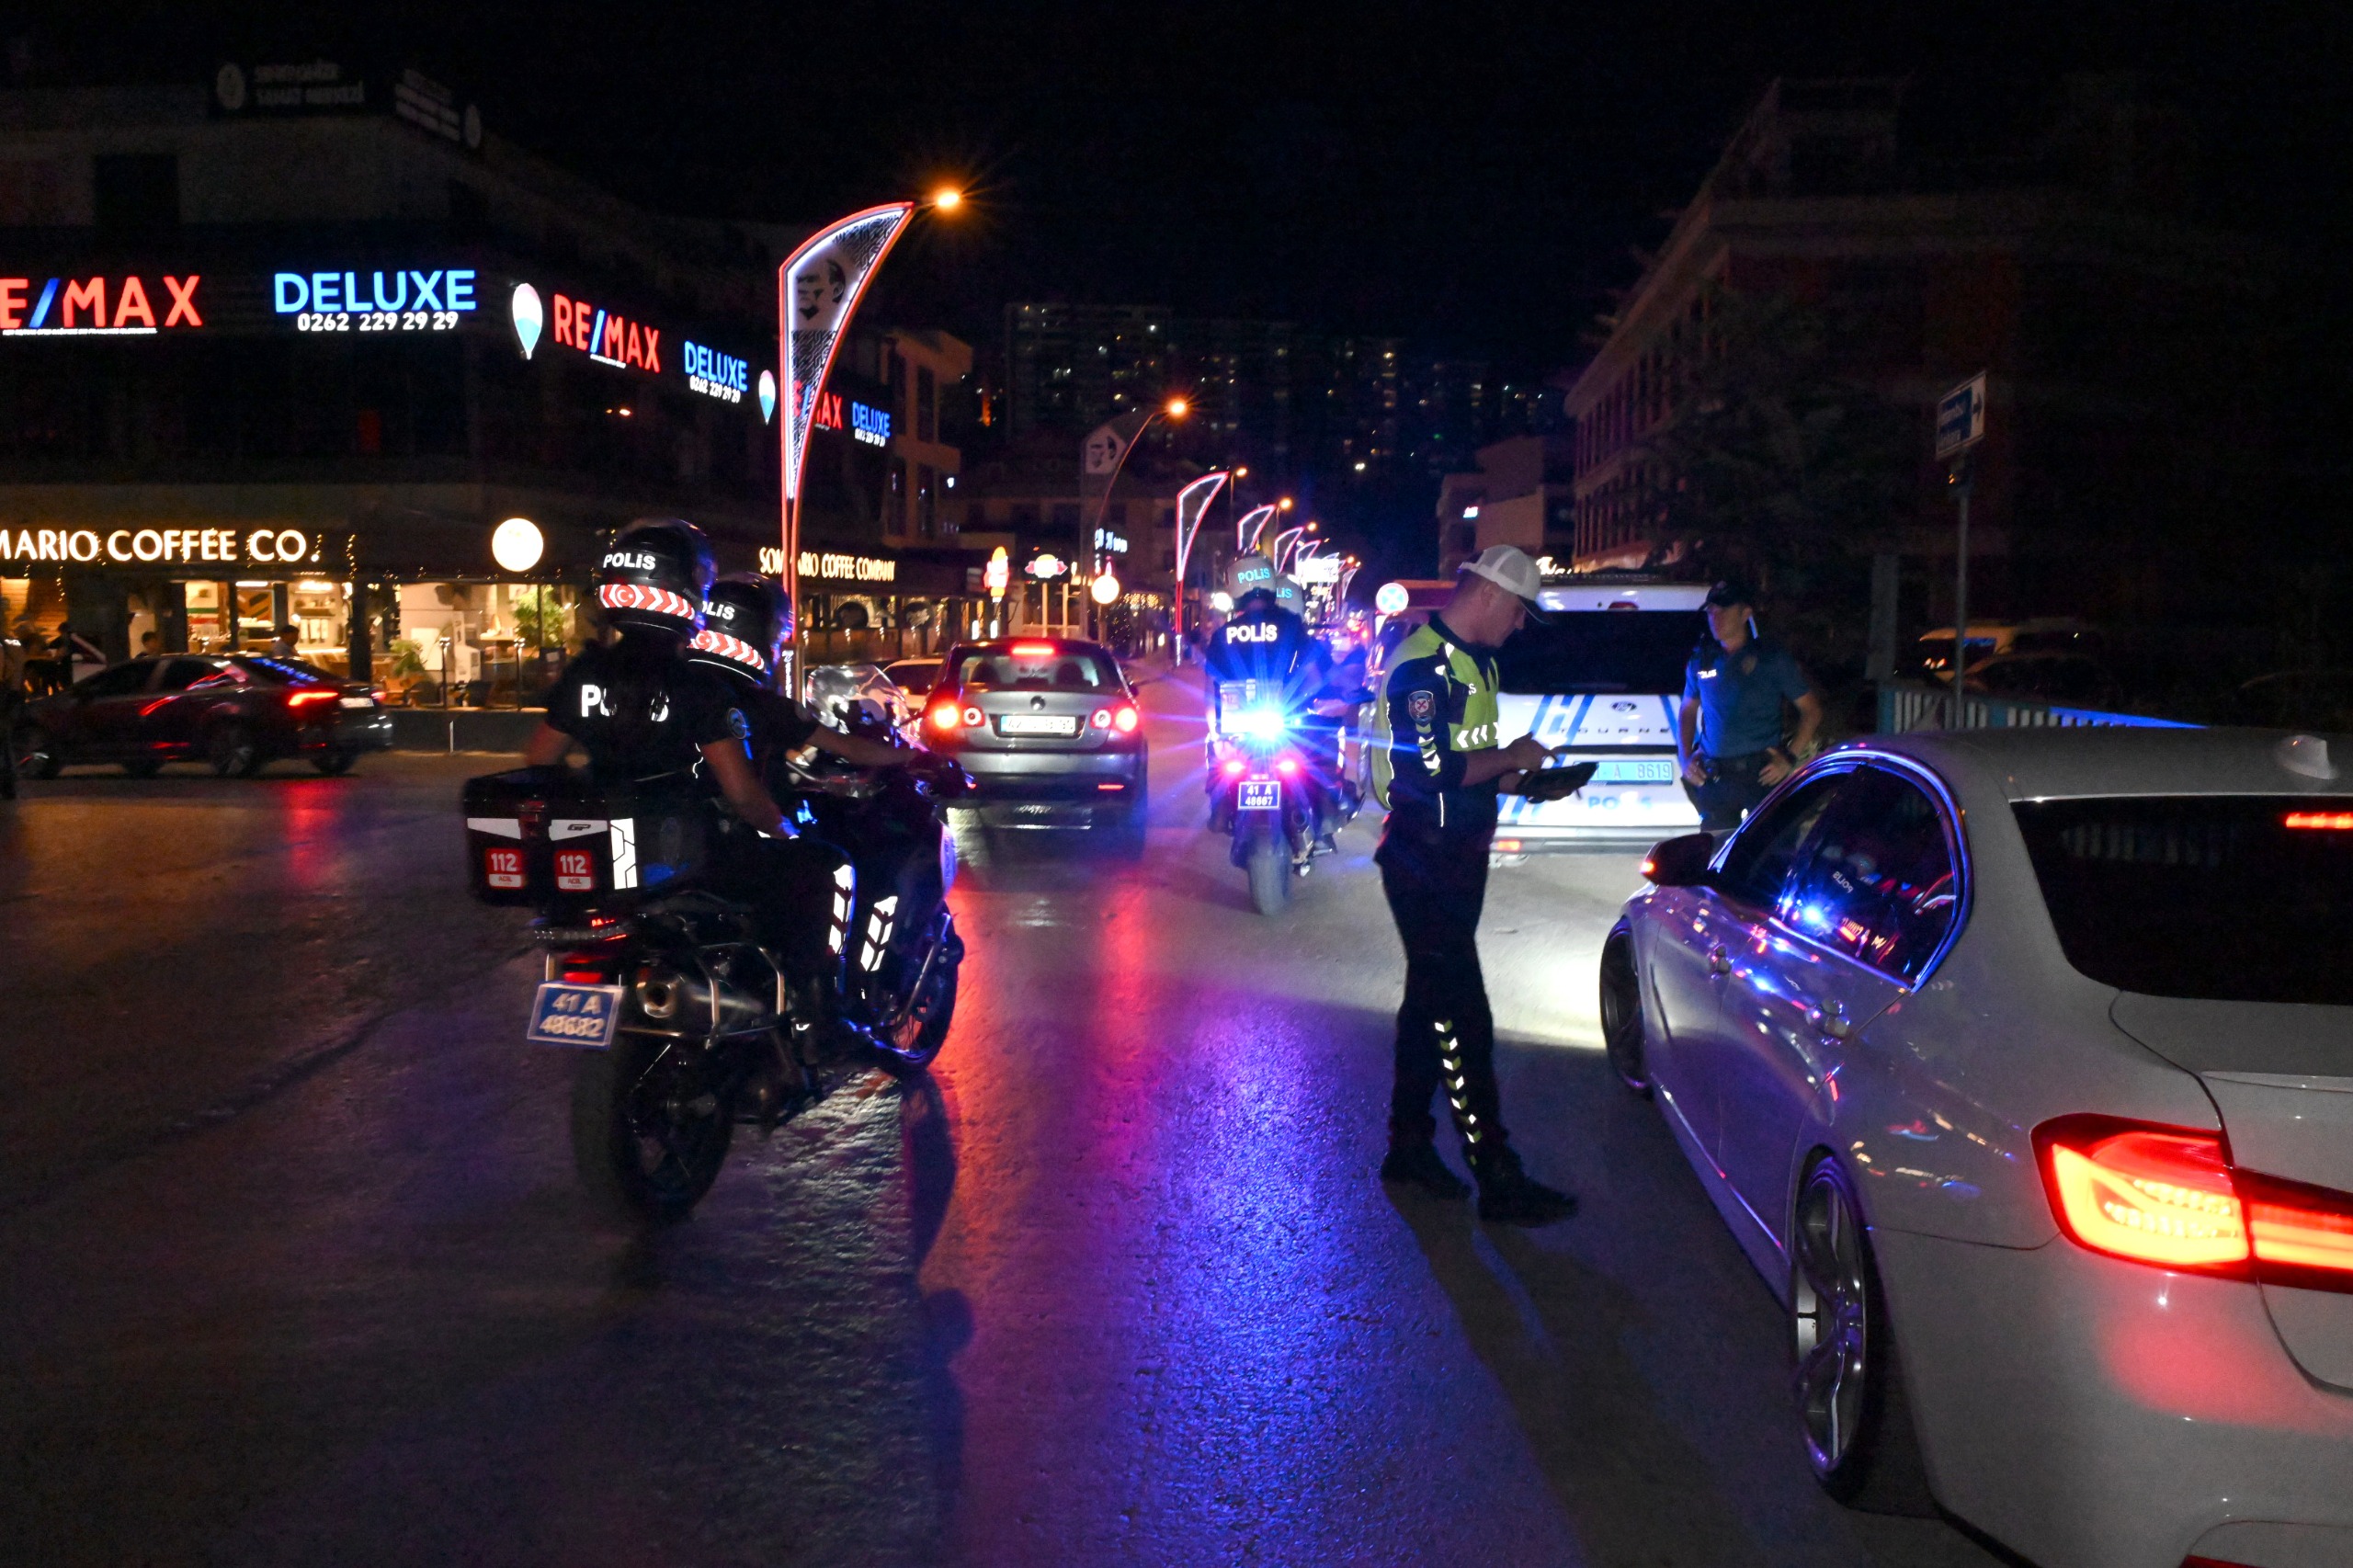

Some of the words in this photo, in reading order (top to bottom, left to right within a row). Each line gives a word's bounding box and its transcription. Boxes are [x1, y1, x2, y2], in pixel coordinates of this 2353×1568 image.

[274, 269, 477, 313] DELUXE
[297, 312, 350, 332] 0262
[358, 312, 399, 332] 229
[403, 311, 428, 331] 29
[433, 311, 459, 331] 29
[553, 293, 661, 373] RE/MAX
[684, 340, 748, 392] DELUXE
[852, 401, 891, 438] DELUXE
[108, 529, 237, 562] COFFEE
[822, 553, 856, 580] COFFEE
[1613, 764, 1622, 779] A
[1637, 764, 1671, 779] 8619
[1247, 785, 1259, 796] 41
[1264, 785, 1272, 796] A
[1588, 796, 1653, 811] POS
[491, 853, 517, 872] 112
[560, 855, 587, 874] 112
[552, 993, 582, 1013] 41
[580, 994, 602, 1015] A
[540, 1014, 605, 1039] 48682
